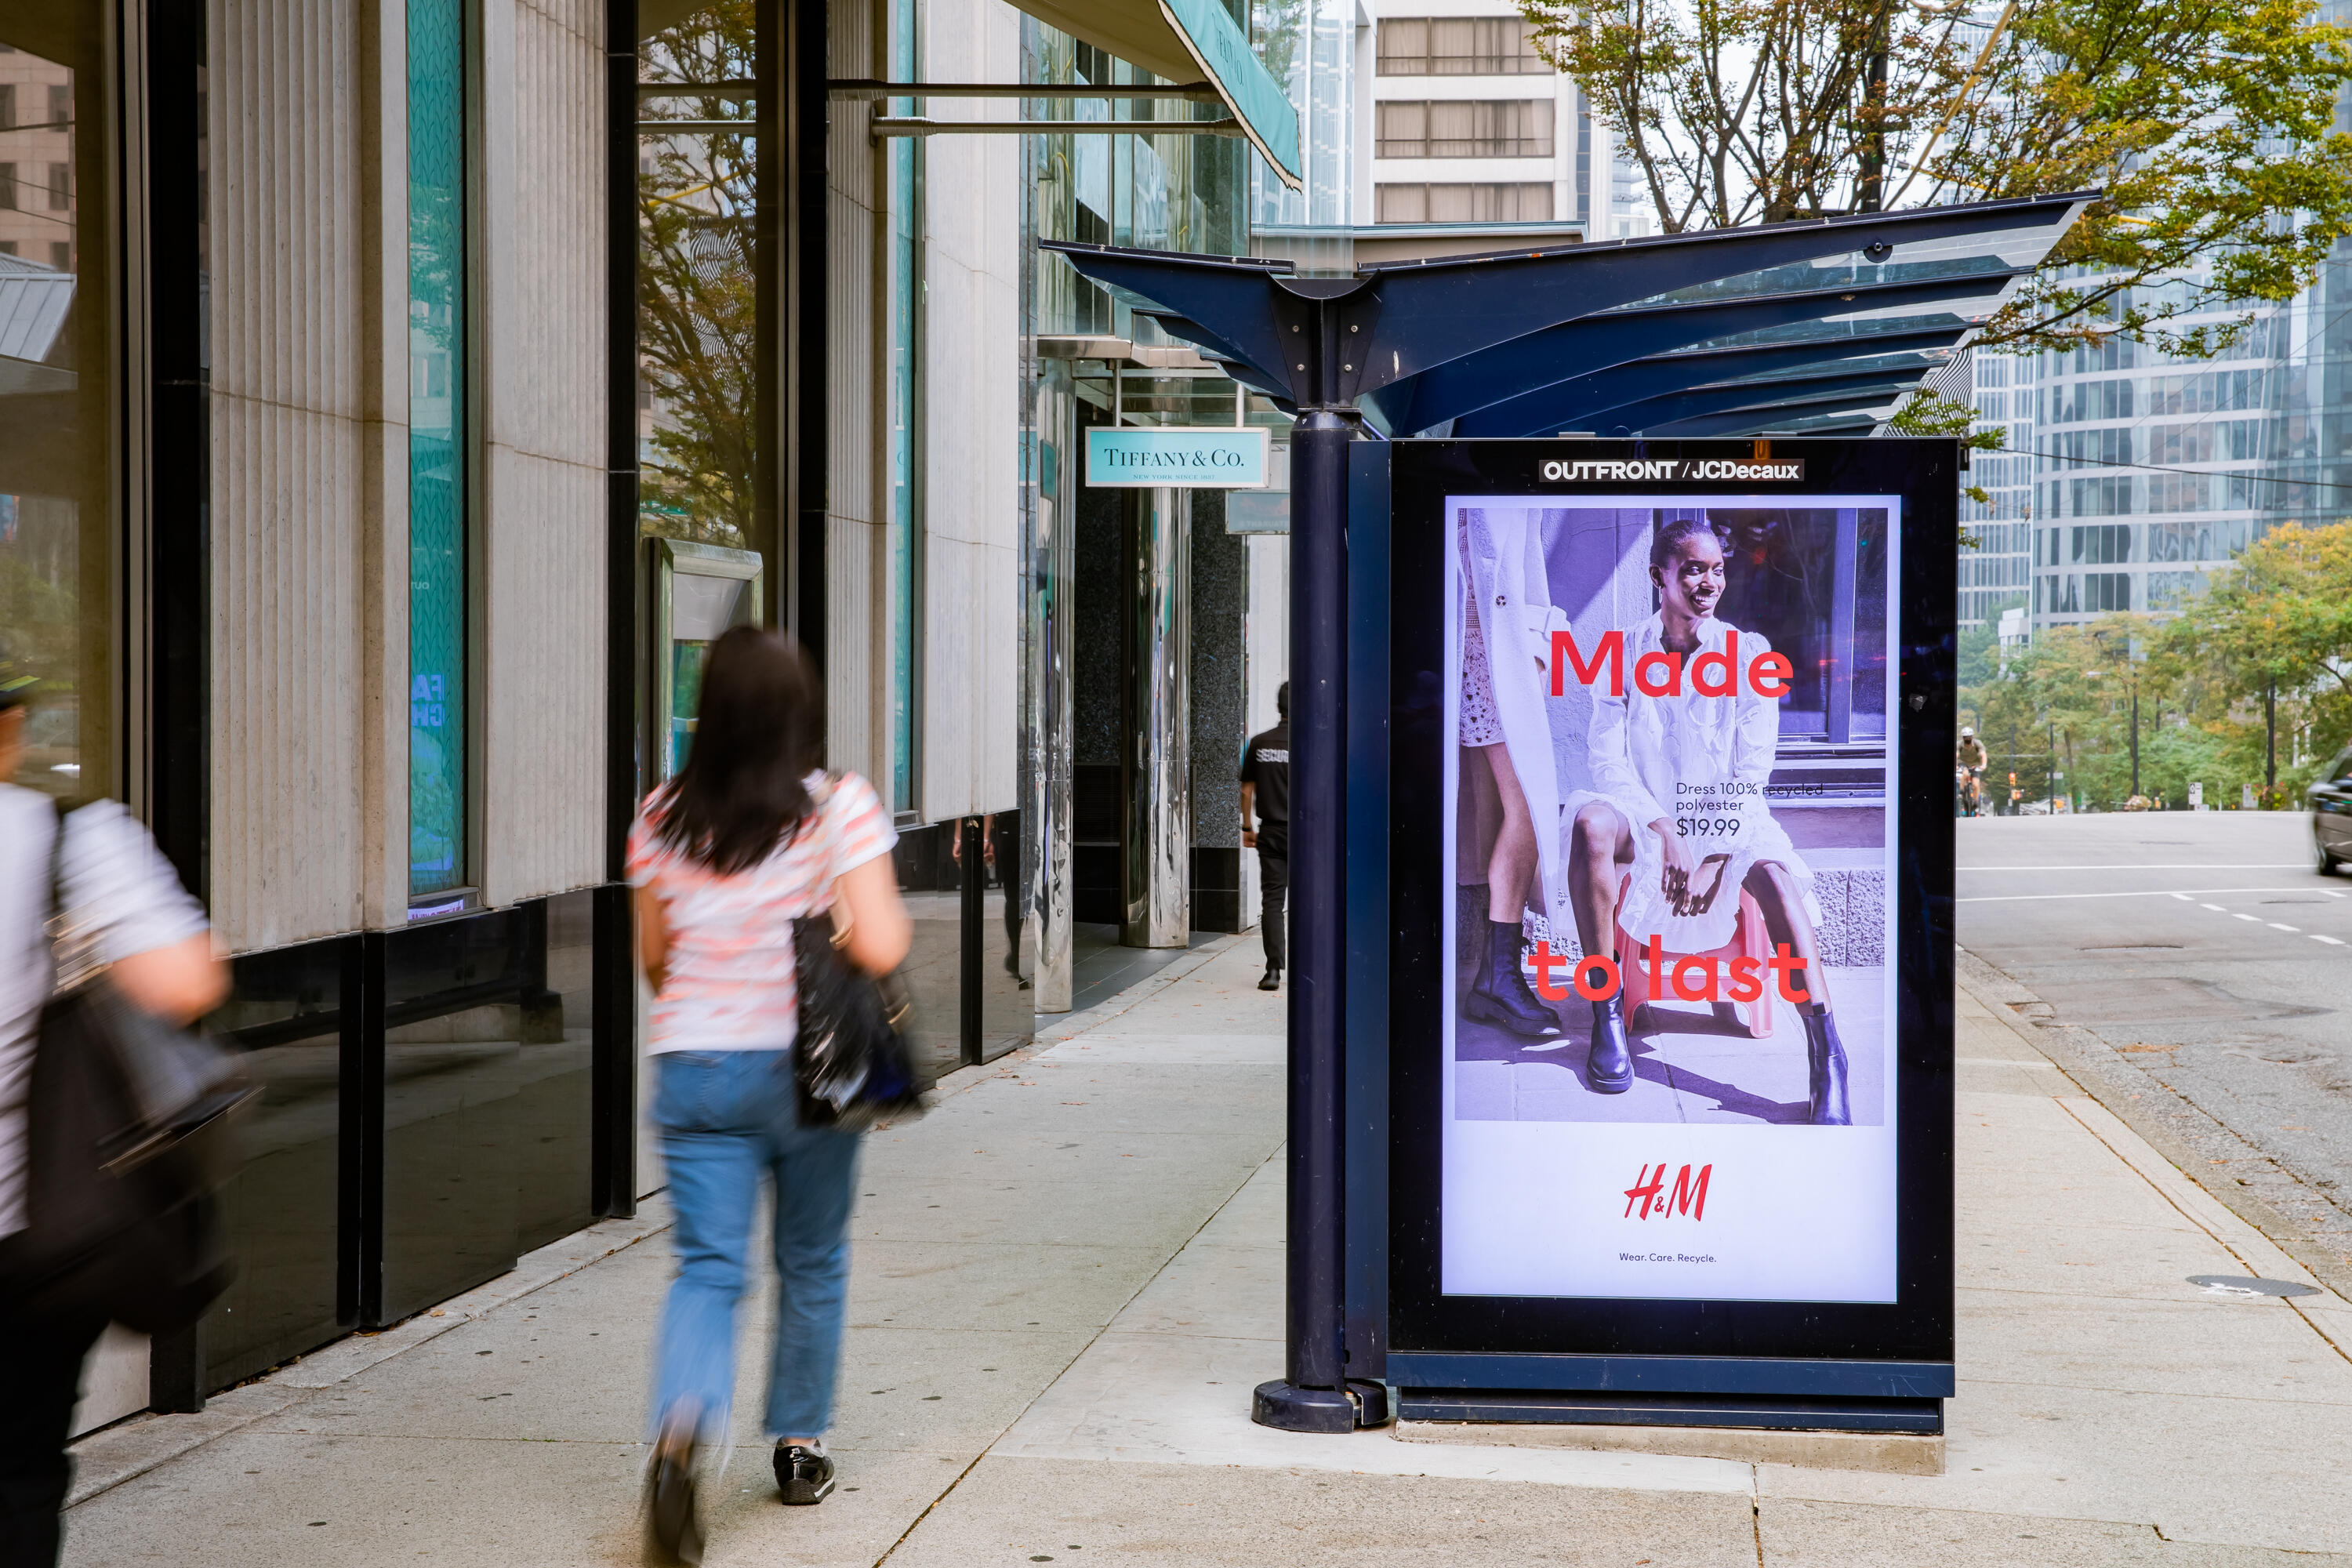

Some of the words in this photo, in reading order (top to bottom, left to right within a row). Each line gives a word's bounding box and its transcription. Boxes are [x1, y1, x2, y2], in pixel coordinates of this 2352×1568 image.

[1104, 448, 1189, 466] TIFFANY
[1192, 450, 1208, 466] &
[1544, 461, 1679, 480] OUTFRONT
[1692, 461, 1799, 479] JCDecaux
[1550, 630, 1794, 698] Made
[1676, 782, 1716, 795] Dress
[1720, 782, 1758, 795] 100%
[1762, 782, 1824, 798] recycled
[1676, 798, 1744, 813] polyester
[1676, 816, 1740, 839] $19.99
[1528, 941, 1621, 1002] to
[1650, 934, 1811, 1004] last
[1624, 1163, 1712, 1221] H&M
[1619, 1253, 1647, 1261] Wear.
[1649, 1253, 1675, 1262] Care.
[1678, 1254, 1717, 1264] Recycle.
